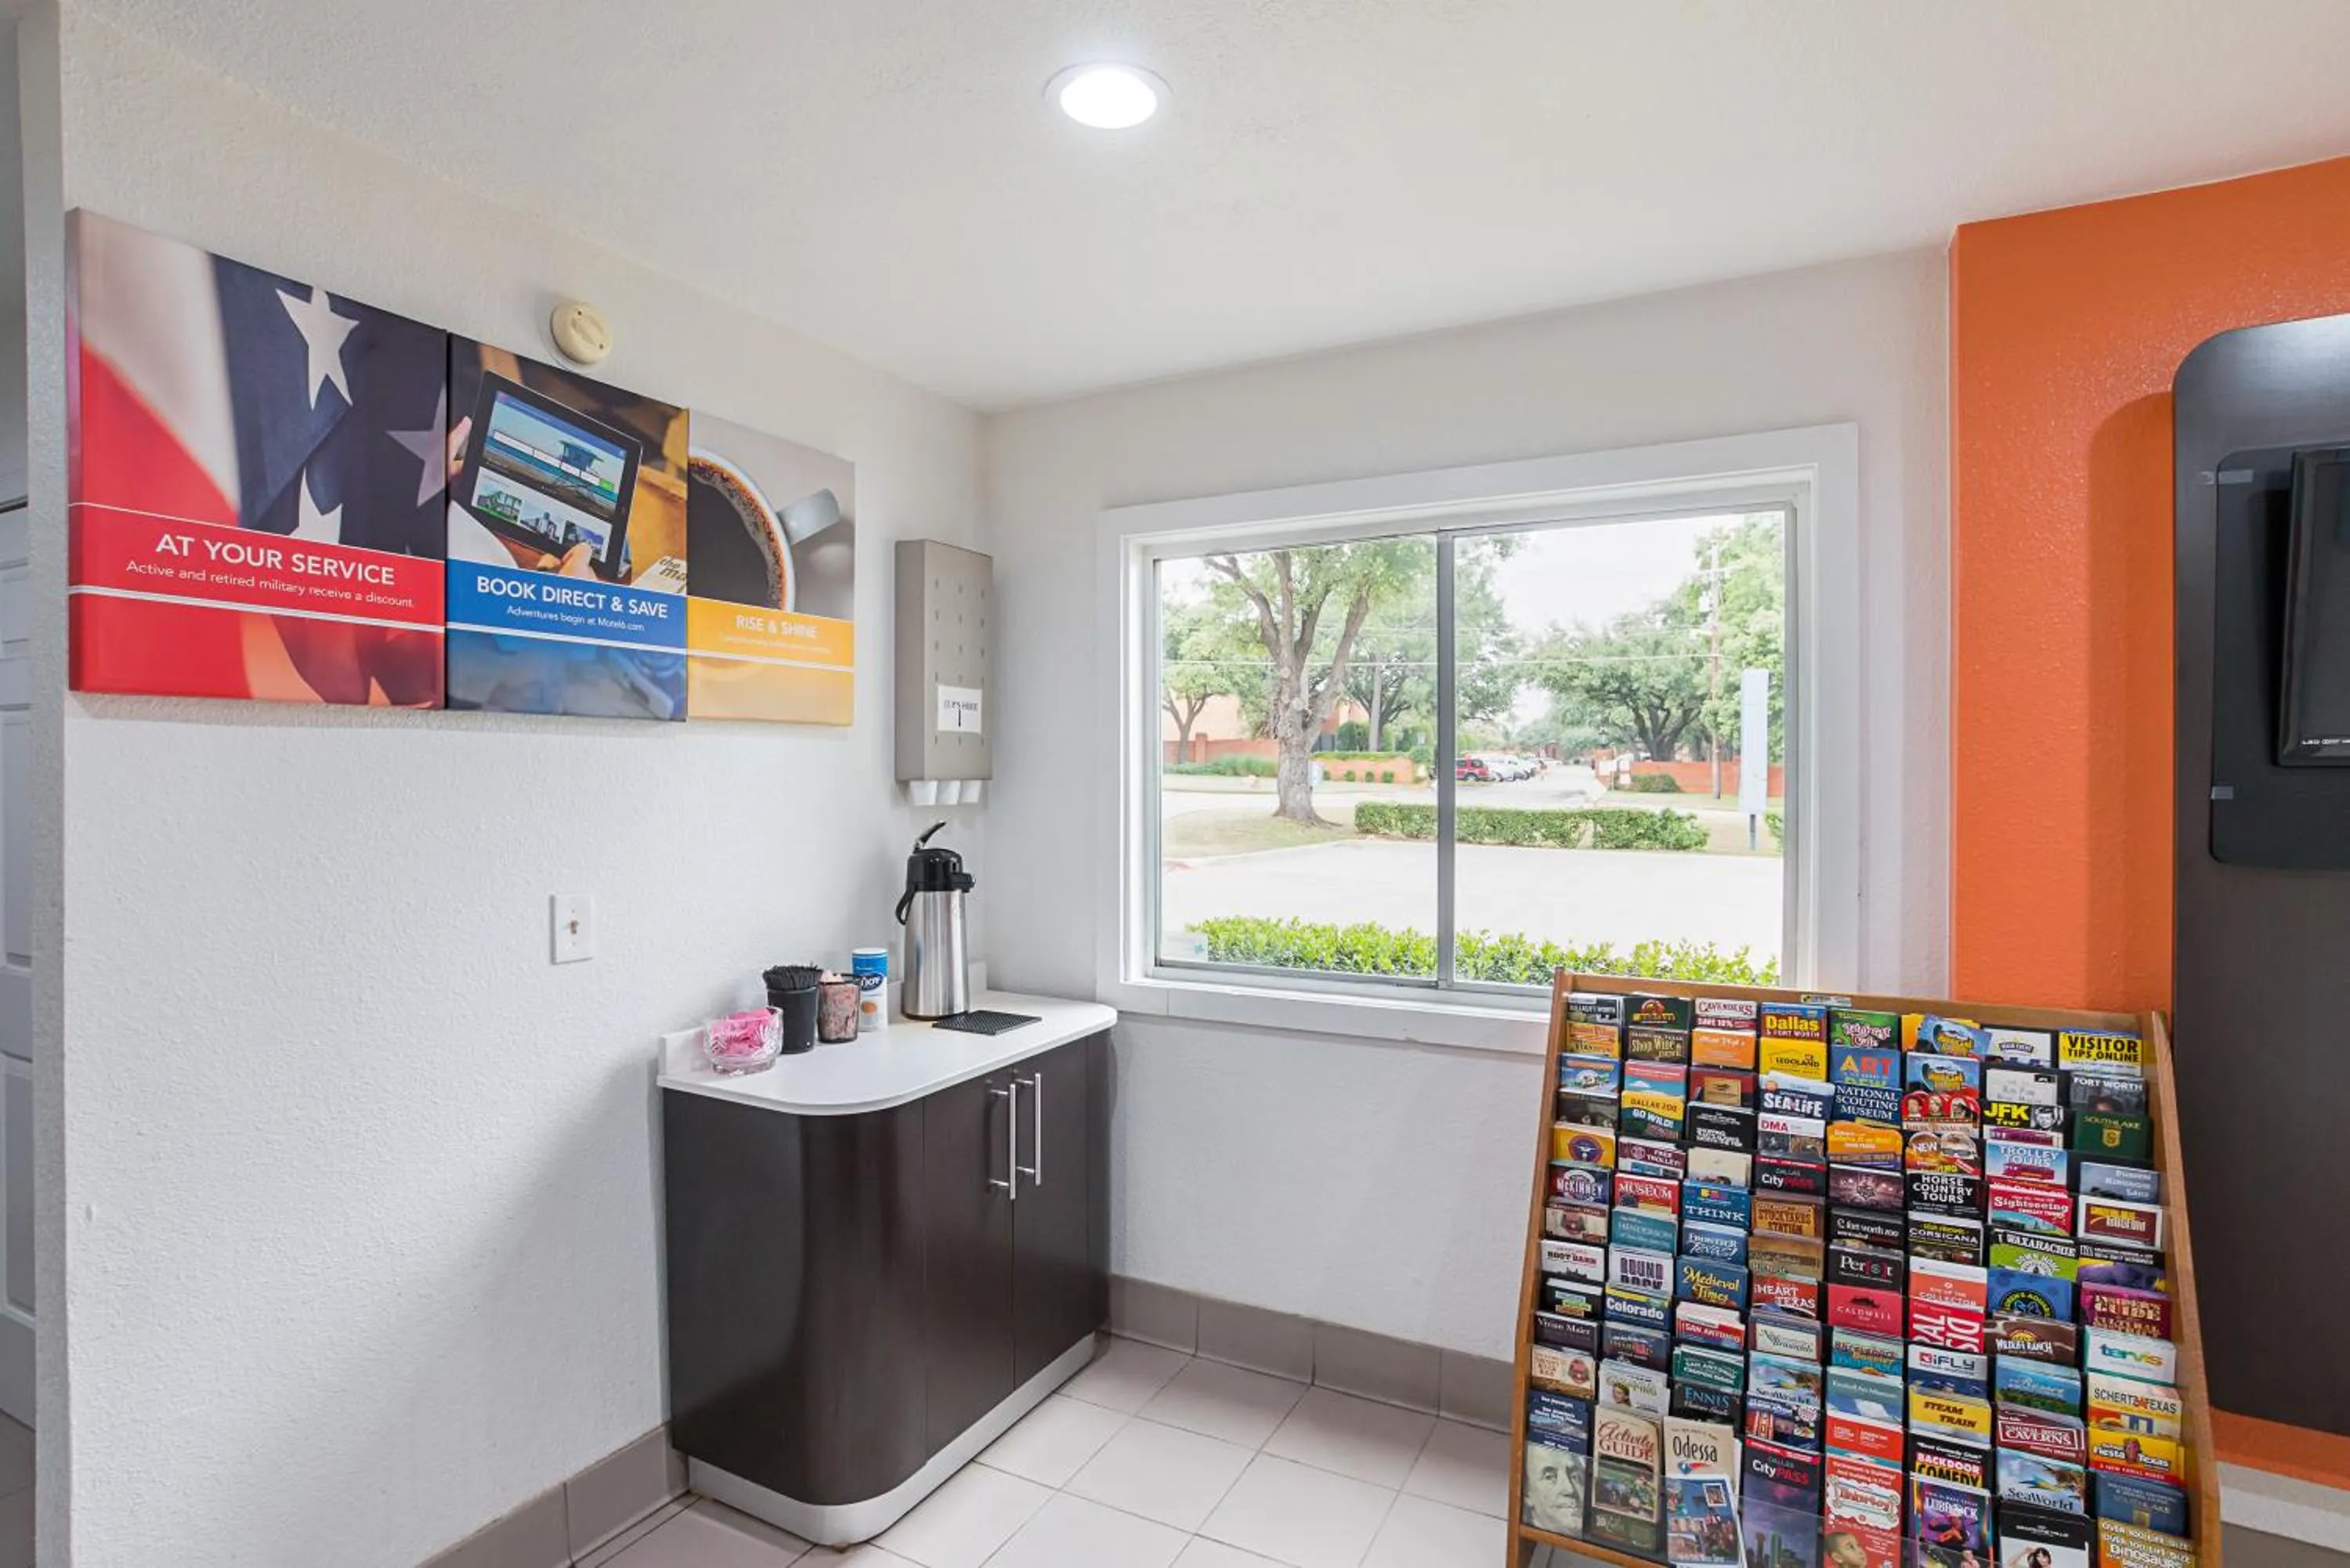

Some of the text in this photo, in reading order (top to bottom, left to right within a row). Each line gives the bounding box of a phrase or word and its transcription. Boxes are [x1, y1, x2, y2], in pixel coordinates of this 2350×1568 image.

[155, 533, 395, 585] AT YOUR SERVICE
[125, 559, 174, 578] Active
[179, 566, 206, 581] and
[211, 572, 255, 588] retired
[259, 578, 306, 596] military
[309, 585, 351, 600] receive
[477, 576, 667, 618] BOOK DIRECT & SAVE
[507, 605, 559, 621] Adventures
[561, 612, 585, 625] begin
[736, 615, 765, 631] RISE
[781, 621, 817, 639] SHINE
[1766, 1015, 1820, 1031] Dallas
[1632, 1038, 1674, 1053] Shop Wine
[2068, 1035, 2138, 1053] VISITOR
[1776, 1057, 1820, 1068] LEGOLAND
[2068, 1049, 2138, 1063] TIPS ONLINE
[1840, 1055, 1892, 1075] ART
[2073, 1077, 2142, 1091] FORT WORTH
[1764, 1093, 1791, 1110] SEA
[1837, 1086, 1897, 1102] NATIONAL
[1630, 1098, 1677, 1112] DALLAS ZOO
[1836, 1097, 1899, 1111] SCOUTING
[1841, 1105, 1892, 1119] MUSEUM
[1984, 1103, 2030, 1121] JFK
[1632, 1108, 1674, 1129] GO WILD!
[1762, 1120, 1788, 1132] DMA
[2084, 1115, 2142, 1129] SOUTHLAKE
[1914, 1142, 1937, 1152] NEW
[2000, 1146, 2059, 1160] TROLLEY
[2005, 1155, 2052, 1167] TOURS
[1922, 1175, 1964, 1187] HORSE
[1619, 1183, 1672, 1198] MUSEUM
[1912, 1183, 1973, 1197] COUNTRY
[1922, 1192, 1964, 1204] TOURS
[1686, 1205, 1744, 1221] THINK
[1994, 1196, 2069, 1213] Sightseeing
[1758, 1209, 1811, 1225] STOCKYARDS
[1618, 1222, 1672, 1239] HENDERSON
[1846, 1221, 1860, 1230] fort
[1860, 1223, 1883, 1235] worth
[1909, 1228, 1978, 1245] CORSICANA
[1689, 1233, 1737, 1248] FRONTIER
[2006, 1236, 2077, 1258] WAXAHACHIE
[1620, 1257, 1663, 1279] ROUND
[1684, 1265, 1740, 1292] Medieval
[1693, 1282, 1729, 1302] Times
[1919, 1292, 1976, 1306] COLLECTOR
[1607, 1297, 1664, 1320] Colorado
[1775, 1296, 1815, 1308] TEXAS
[1837, 1306, 1892, 1321] CALDWELL
[1538, 1317, 1591, 1335] Vivian Maier
[1686, 1324, 1741, 1342] SAN ANTONIO
[2026, 1341, 2053, 1354] RANCH
[1932, 1354, 1975, 1371] iFLY
[1685, 1387, 1730, 1407] ENNIS
[2145, 1397, 2176, 1414] TEXAS
[1924, 1400, 1964, 1415] STEAM
[1940, 1414, 1978, 1428] TRAIN
[1598, 1422, 1654, 1450] Activity
[2006, 1429, 2072, 1446] CAVERNS
[1600, 1439, 1654, 1462] GUIDE
[1672, 1435, 1718, 1462] Odessa
[2093, 1446, 2125, 1459] Fiesta
[1767, 1455, 1795, 1469] DALLAS
[1917, 1453, 1979, 1474] BACKDOOR
[1752, 1459, 1809, 1486] CityPASS
[1918, 1464, 1979, 1486] COMEDY
[2007, 1487, 2073, 1512] SeaWorld
[1924, 1497, 1978, 1520] LUBBOCK
